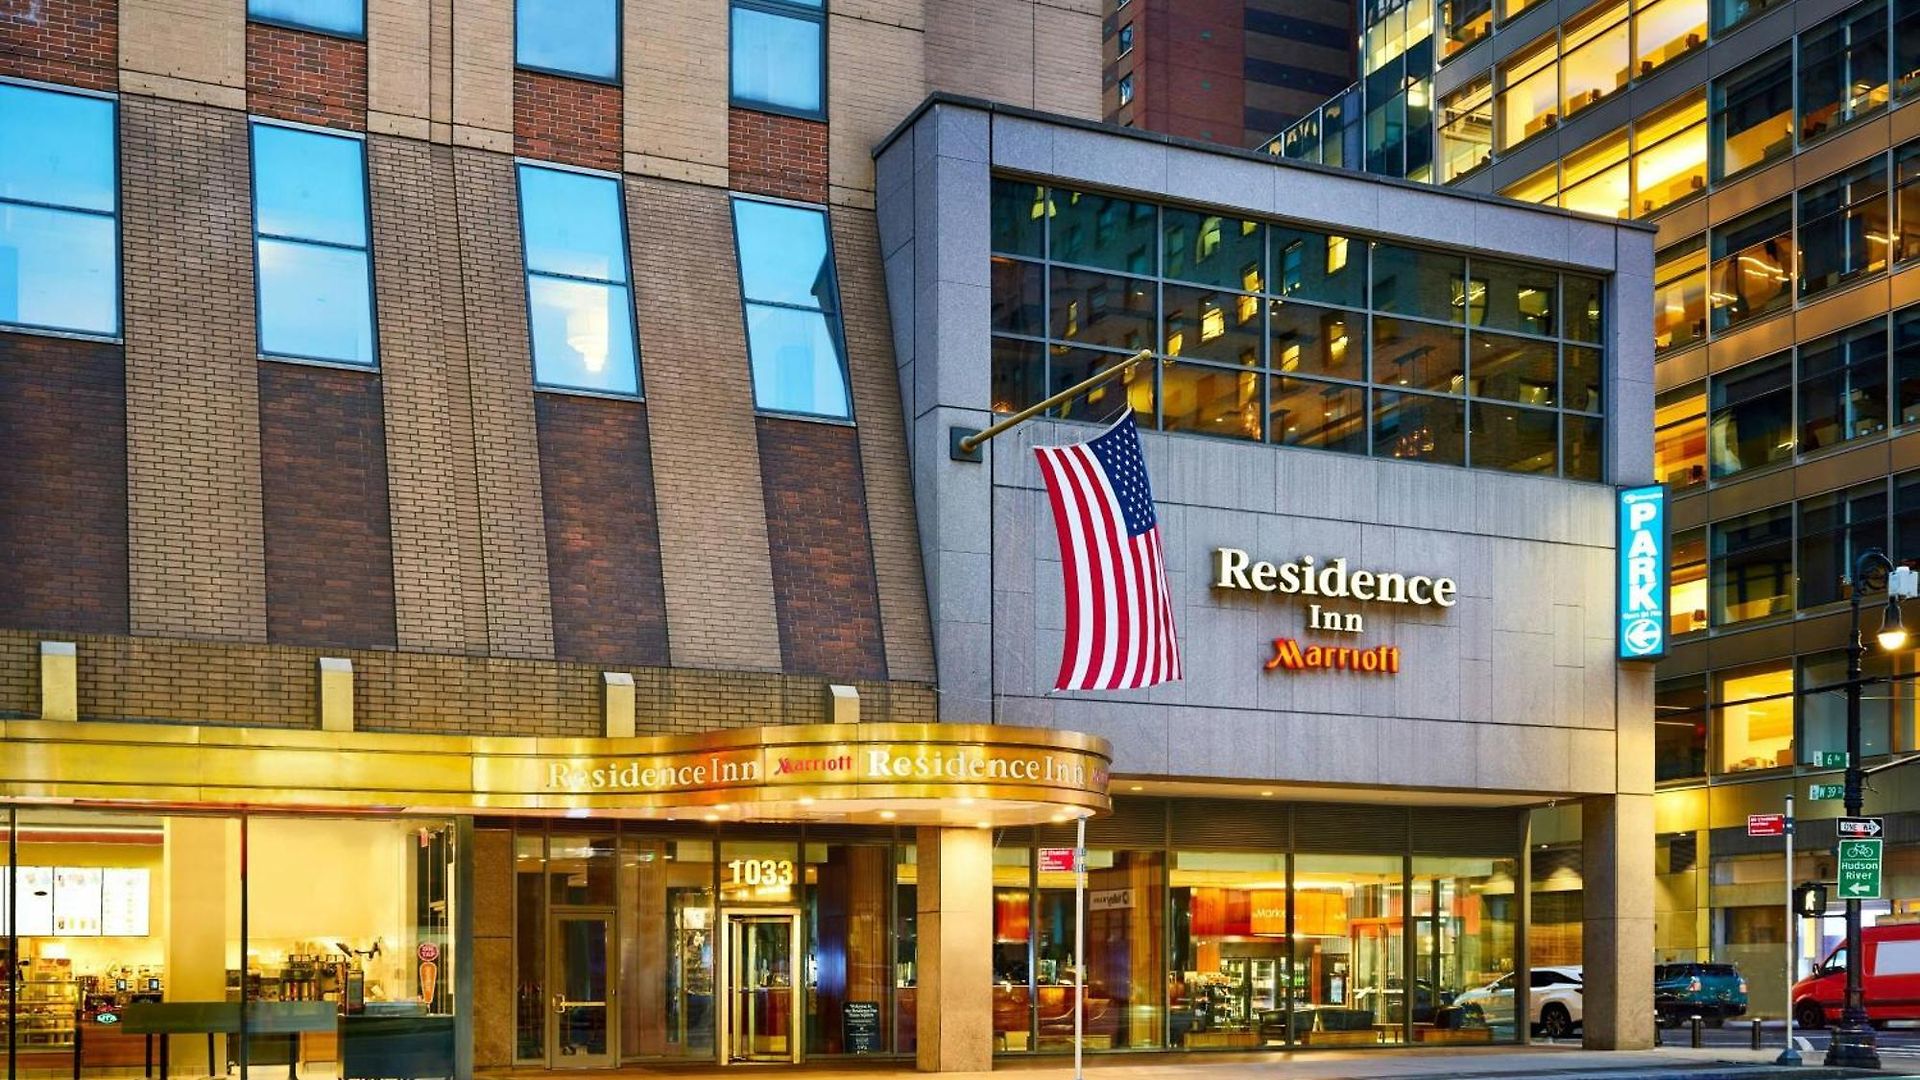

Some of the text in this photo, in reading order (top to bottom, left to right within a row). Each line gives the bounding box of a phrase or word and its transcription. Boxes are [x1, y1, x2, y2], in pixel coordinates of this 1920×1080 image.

[1628, 502, 1658, 612] PARK
[1217, 547, 1457, 607] Residence
[1309, 604, 1364, 633] Inn
[1265, 637, 1400, 674] Marriott
[549, 762, 706, 788] Residence
[711, 758, 760, 783] Inn
[774, 755, 852, 775] Marriott
[868, 750, 1038, 780] Residence
[1044, 756, 1084, 785] Inn
[1827, 754, 1833, 765] 6
[1827, 786, 1837, 798] 39
[1843, 823, 1857, 831] ONE
[728, 859, 793, 887] 1033
[1841, 862, 1879, 870] Hudson
[1846, 871, 1872, 880] River
